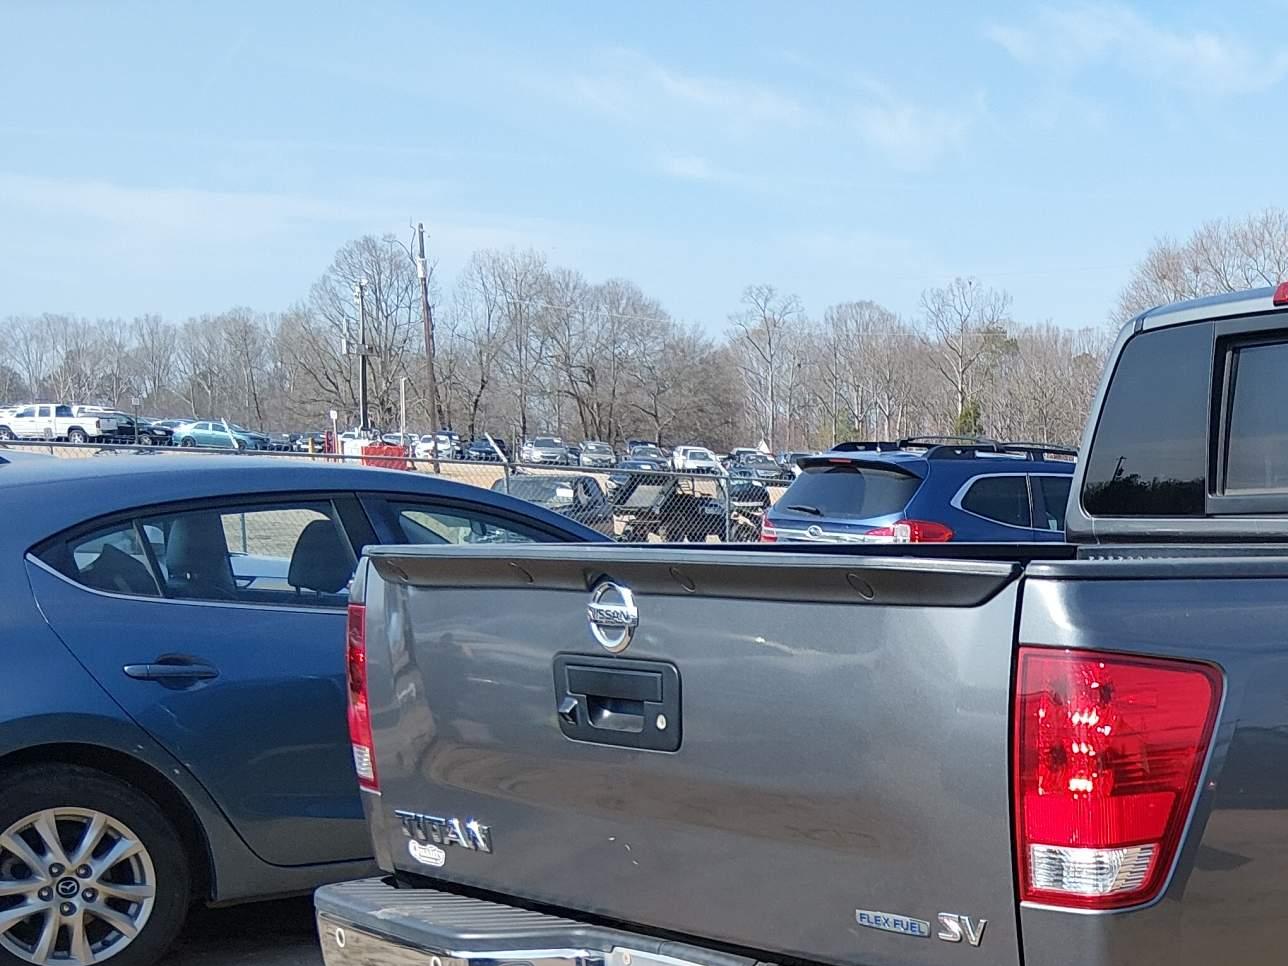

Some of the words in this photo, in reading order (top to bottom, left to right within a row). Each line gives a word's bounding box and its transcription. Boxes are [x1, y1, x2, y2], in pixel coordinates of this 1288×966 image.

[588, 606, 631, 621] NISSAN
[394, 809, 493, 854] TITAN
[859, 912, 891, 929] FLEX
[893, 918, 925, 935] FUEL
[937, 912, 987, 947] SV
